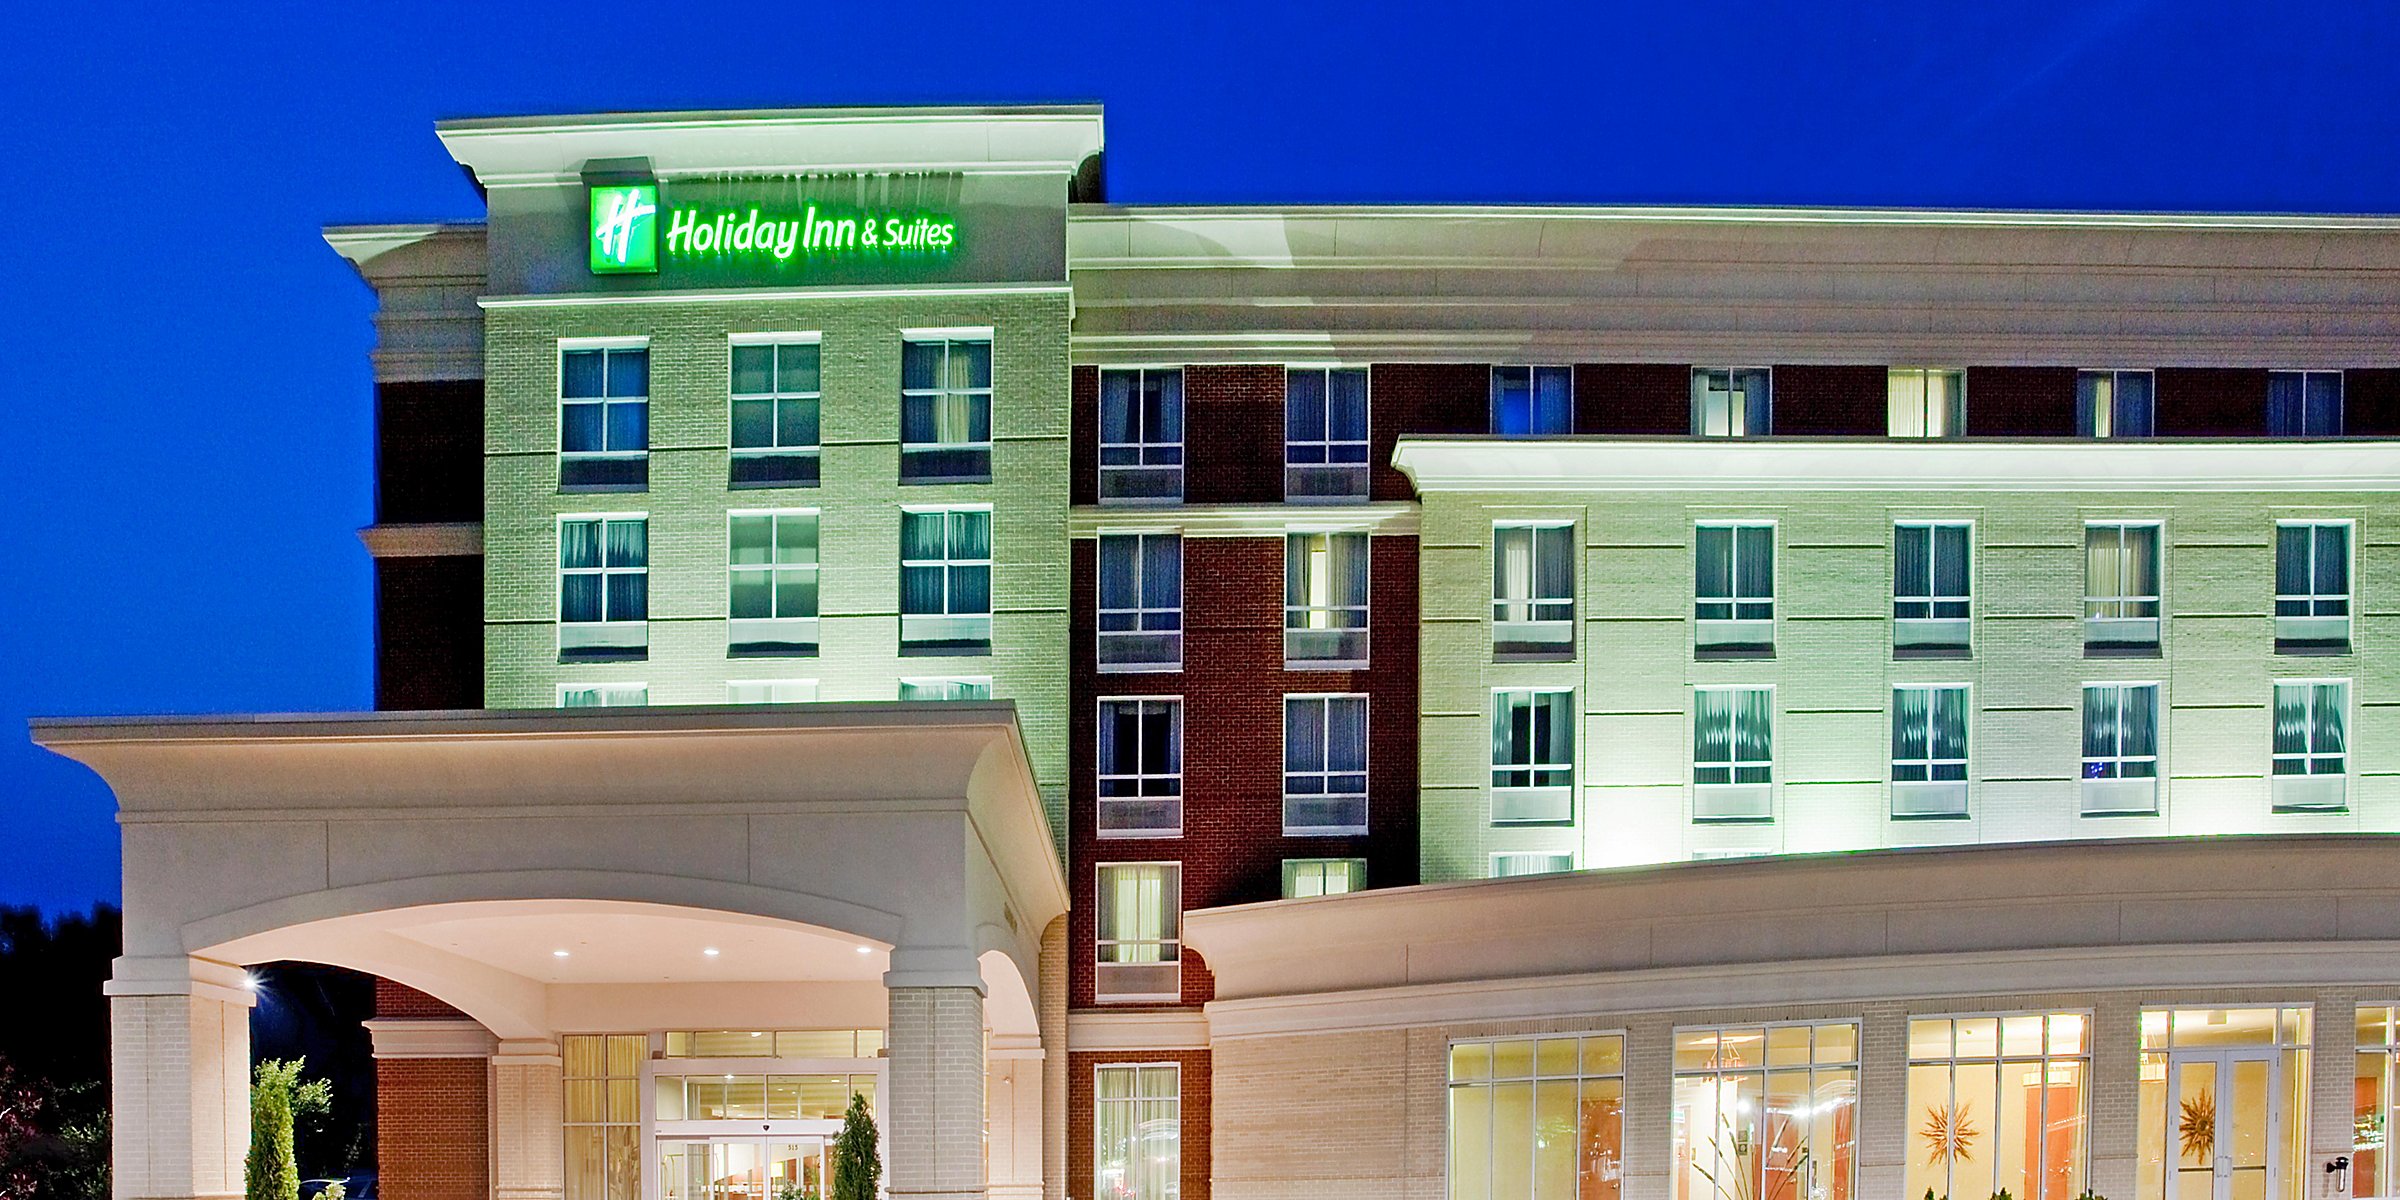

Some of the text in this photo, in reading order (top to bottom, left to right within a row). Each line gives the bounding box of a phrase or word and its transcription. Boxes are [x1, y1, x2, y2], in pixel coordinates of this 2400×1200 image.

[666, 206, 954, 259] Holiday Inn & Suites
